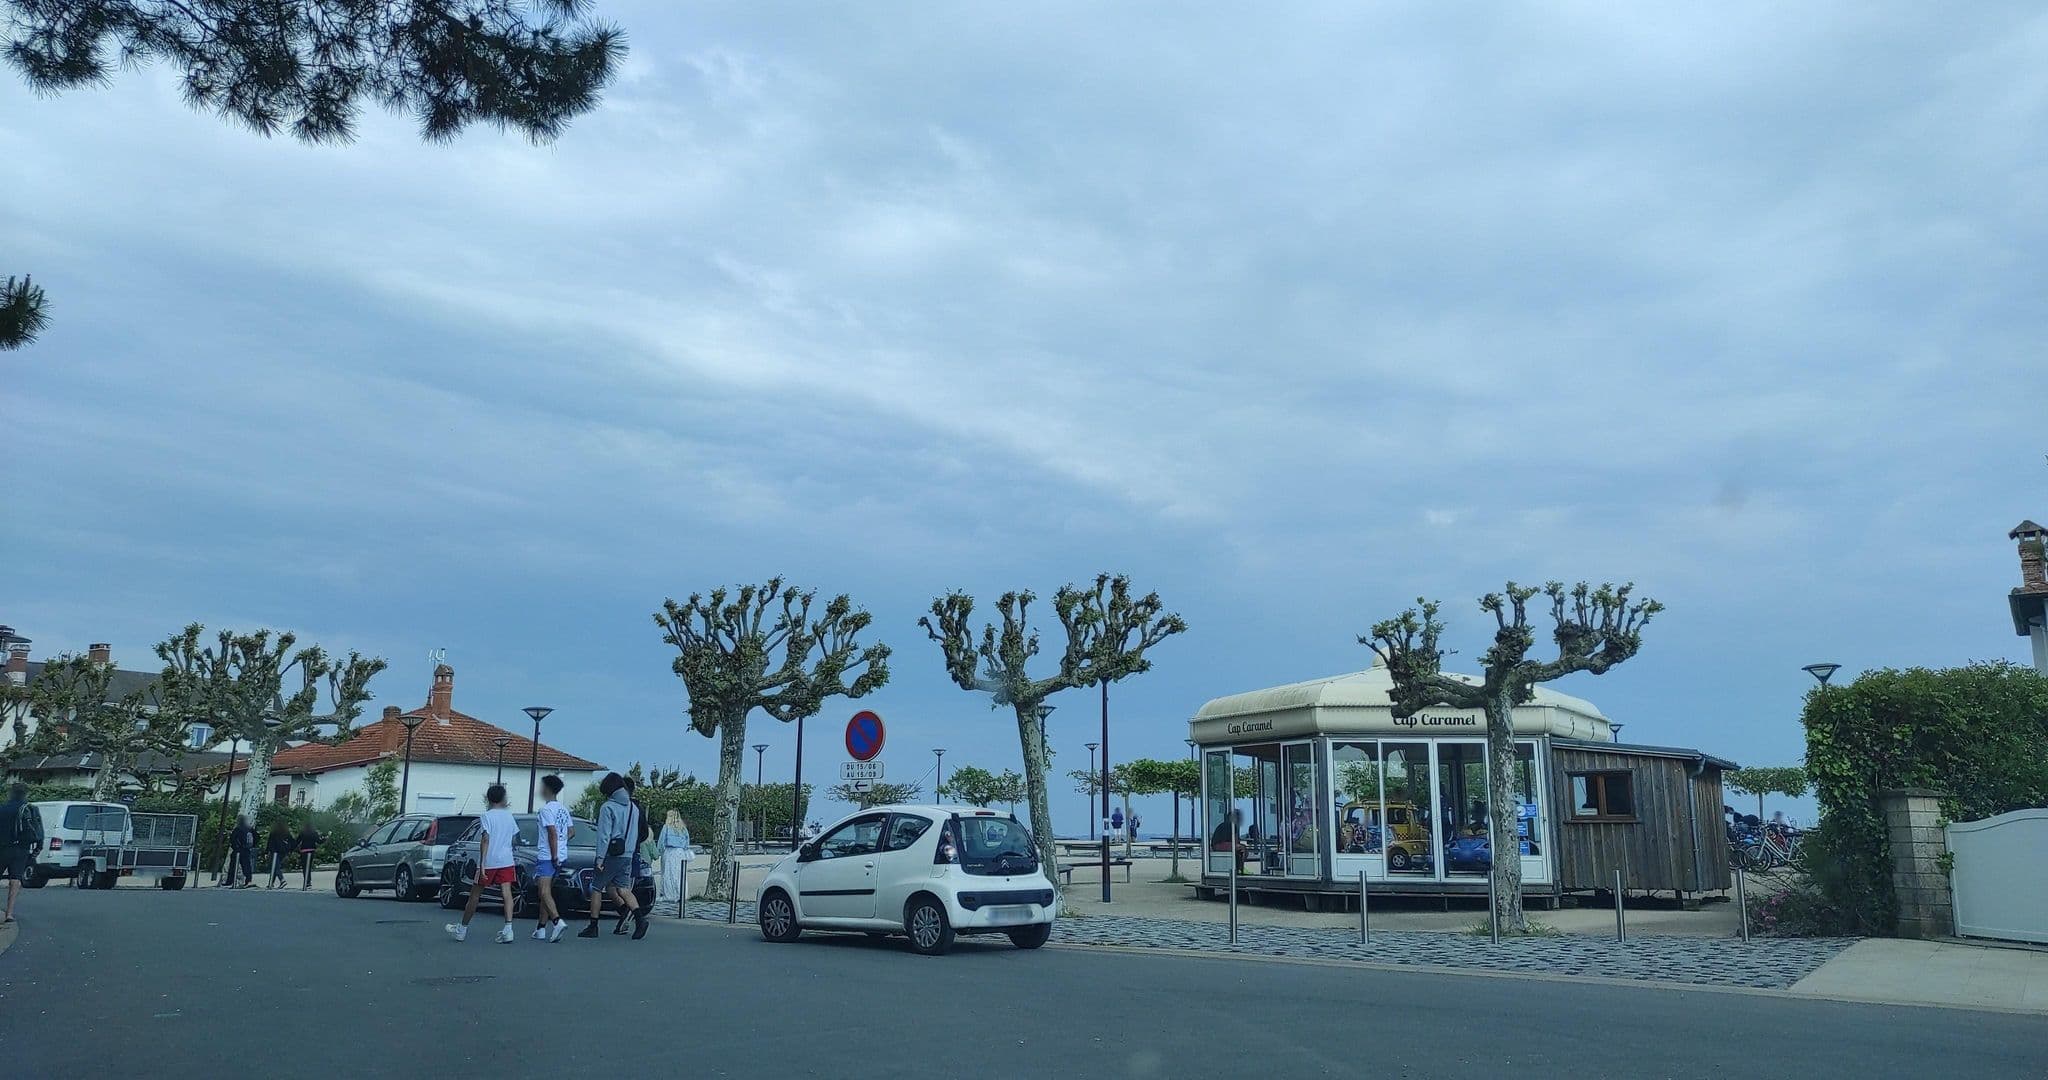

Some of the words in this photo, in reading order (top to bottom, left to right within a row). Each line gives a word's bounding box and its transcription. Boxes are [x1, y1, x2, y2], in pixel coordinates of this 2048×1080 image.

[1421, 713, 1476, 726] Caramel
[1227, 722, 1241, 736] Cap
[1242, 719, 1273, 733] Caramel
